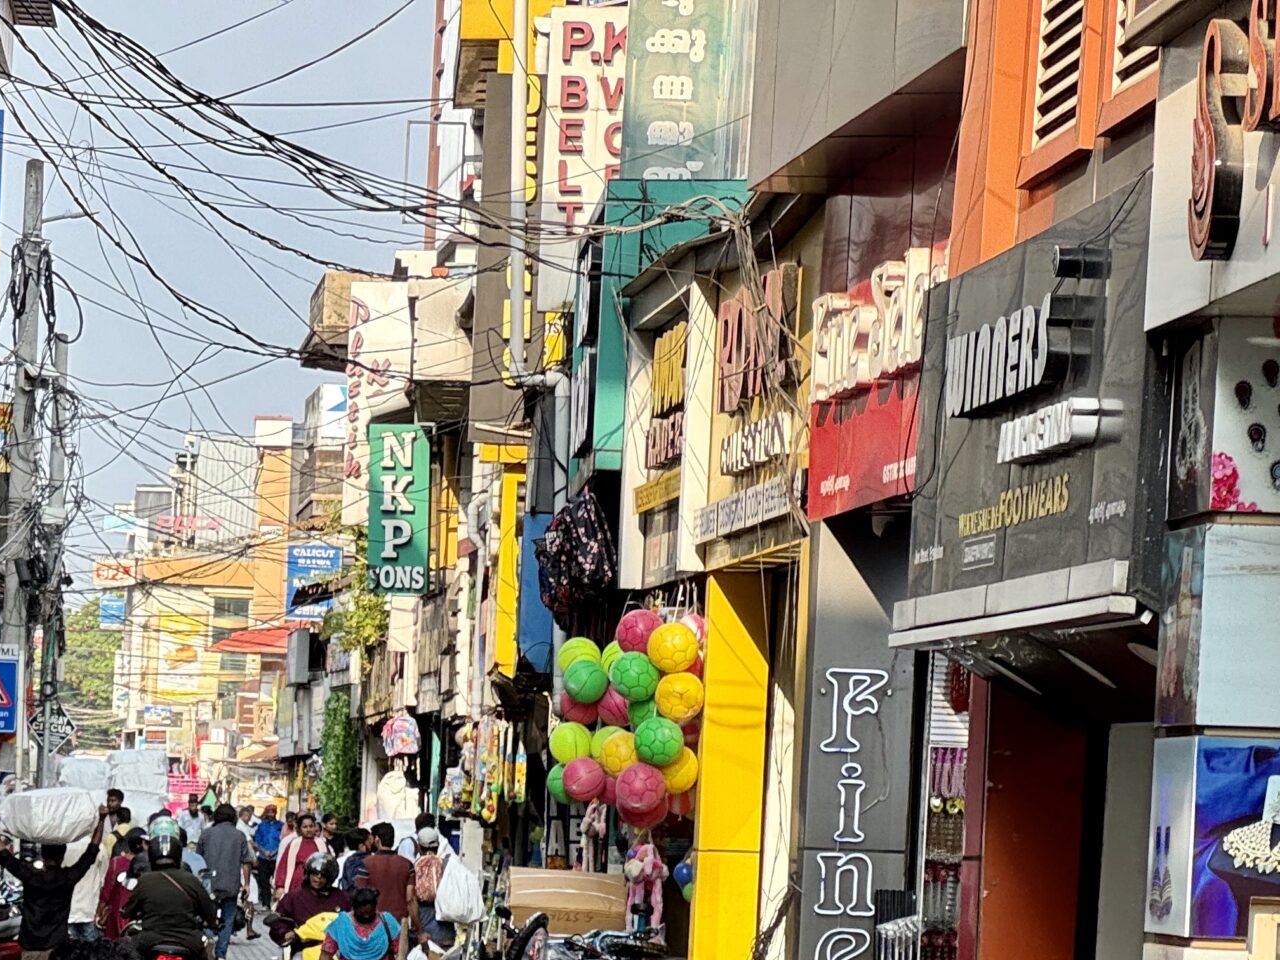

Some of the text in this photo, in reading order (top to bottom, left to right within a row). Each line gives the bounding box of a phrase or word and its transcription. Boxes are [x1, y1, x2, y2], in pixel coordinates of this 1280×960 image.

[946, 293, 1052, 418] WINNERS
[380, 431, 417, 559] NKP
[1000, 472, 1069, 528] FOOTWEARS
[293, 550, 336, 559] CALICUT
[32, 721, 72, 732] CICUS
